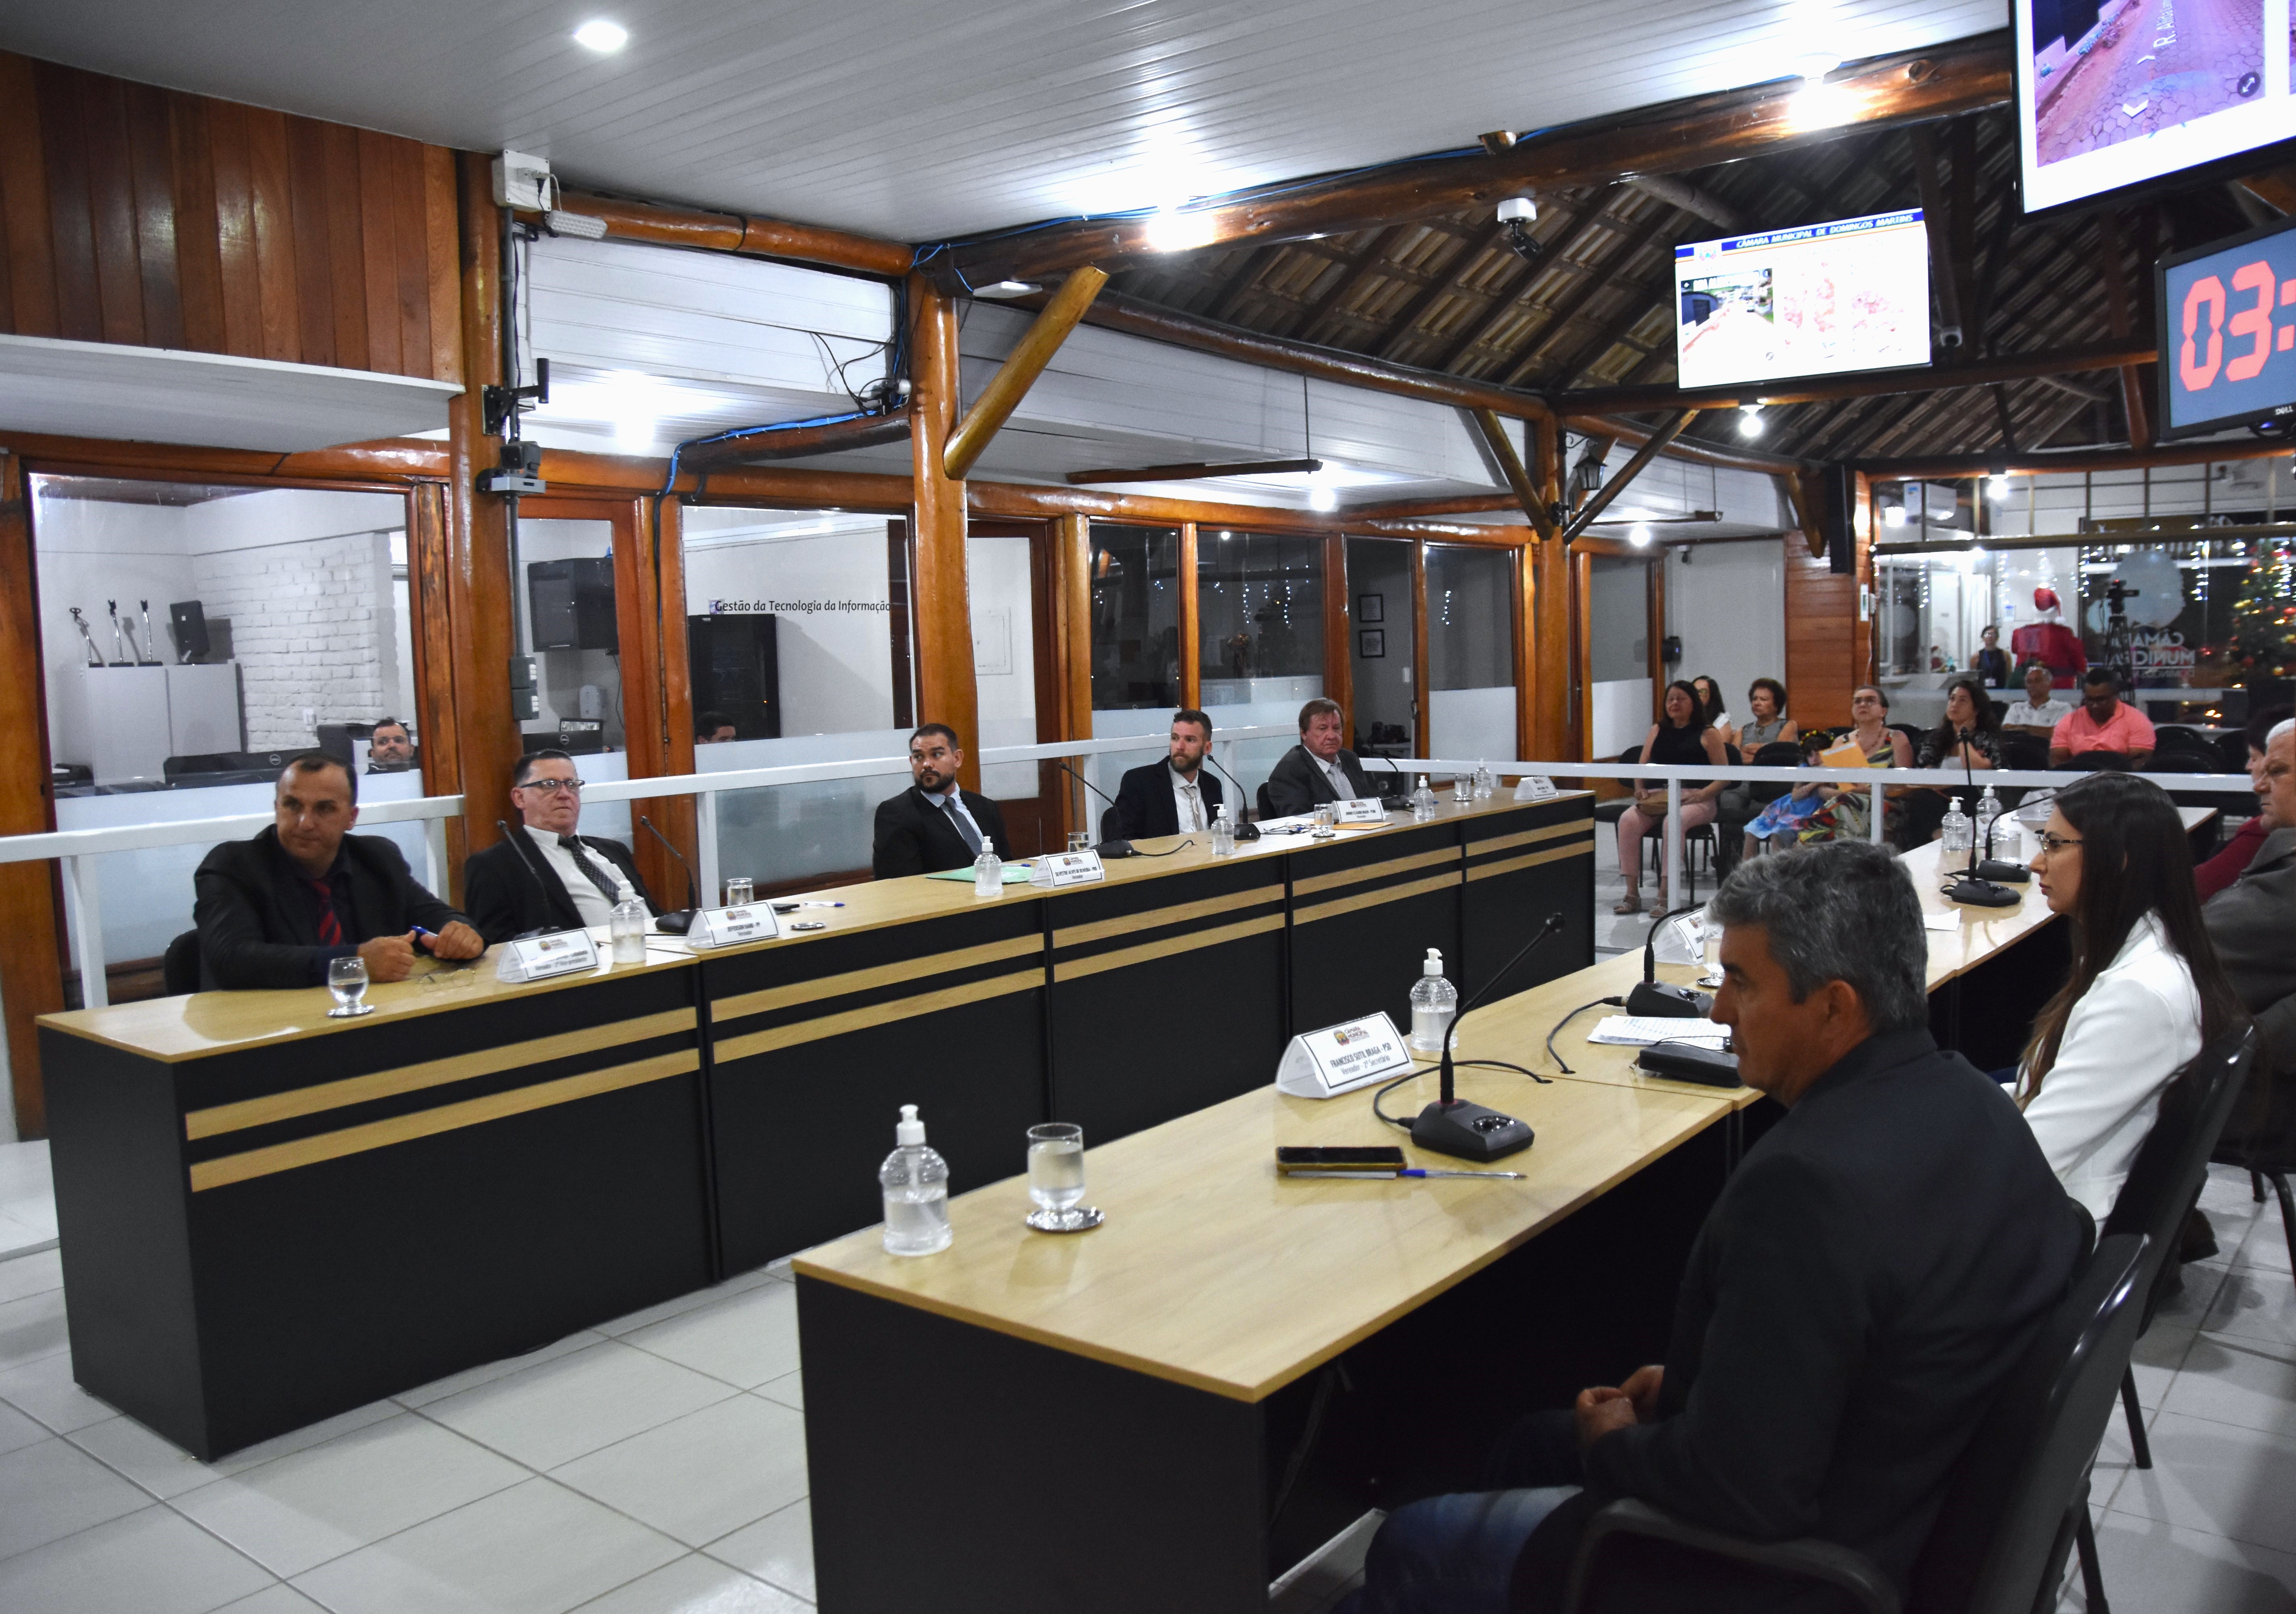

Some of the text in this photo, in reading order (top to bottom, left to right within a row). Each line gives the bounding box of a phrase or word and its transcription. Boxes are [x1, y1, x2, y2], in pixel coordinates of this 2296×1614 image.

[2153, 31, 2177, 48] R.
[1736, 214, 1913, 249] CÂMARA MUNICIPAL DE DOMINGOS MARTINS
[715, 600, 890, 614] Gestão da Tecnologia da Informação
[1330, 1054, 1354, 1068] FRANCISCO
[1353, 1051, 1367, 1061] SUTIL
[1365, 1046, 1381, 1057] BRAGA
[1382, 1043, 1392, 1052] PSD
[1340, 1064, 1360, 1075] Vereador
[1369, 1055, 1390, 1066] Secretário
